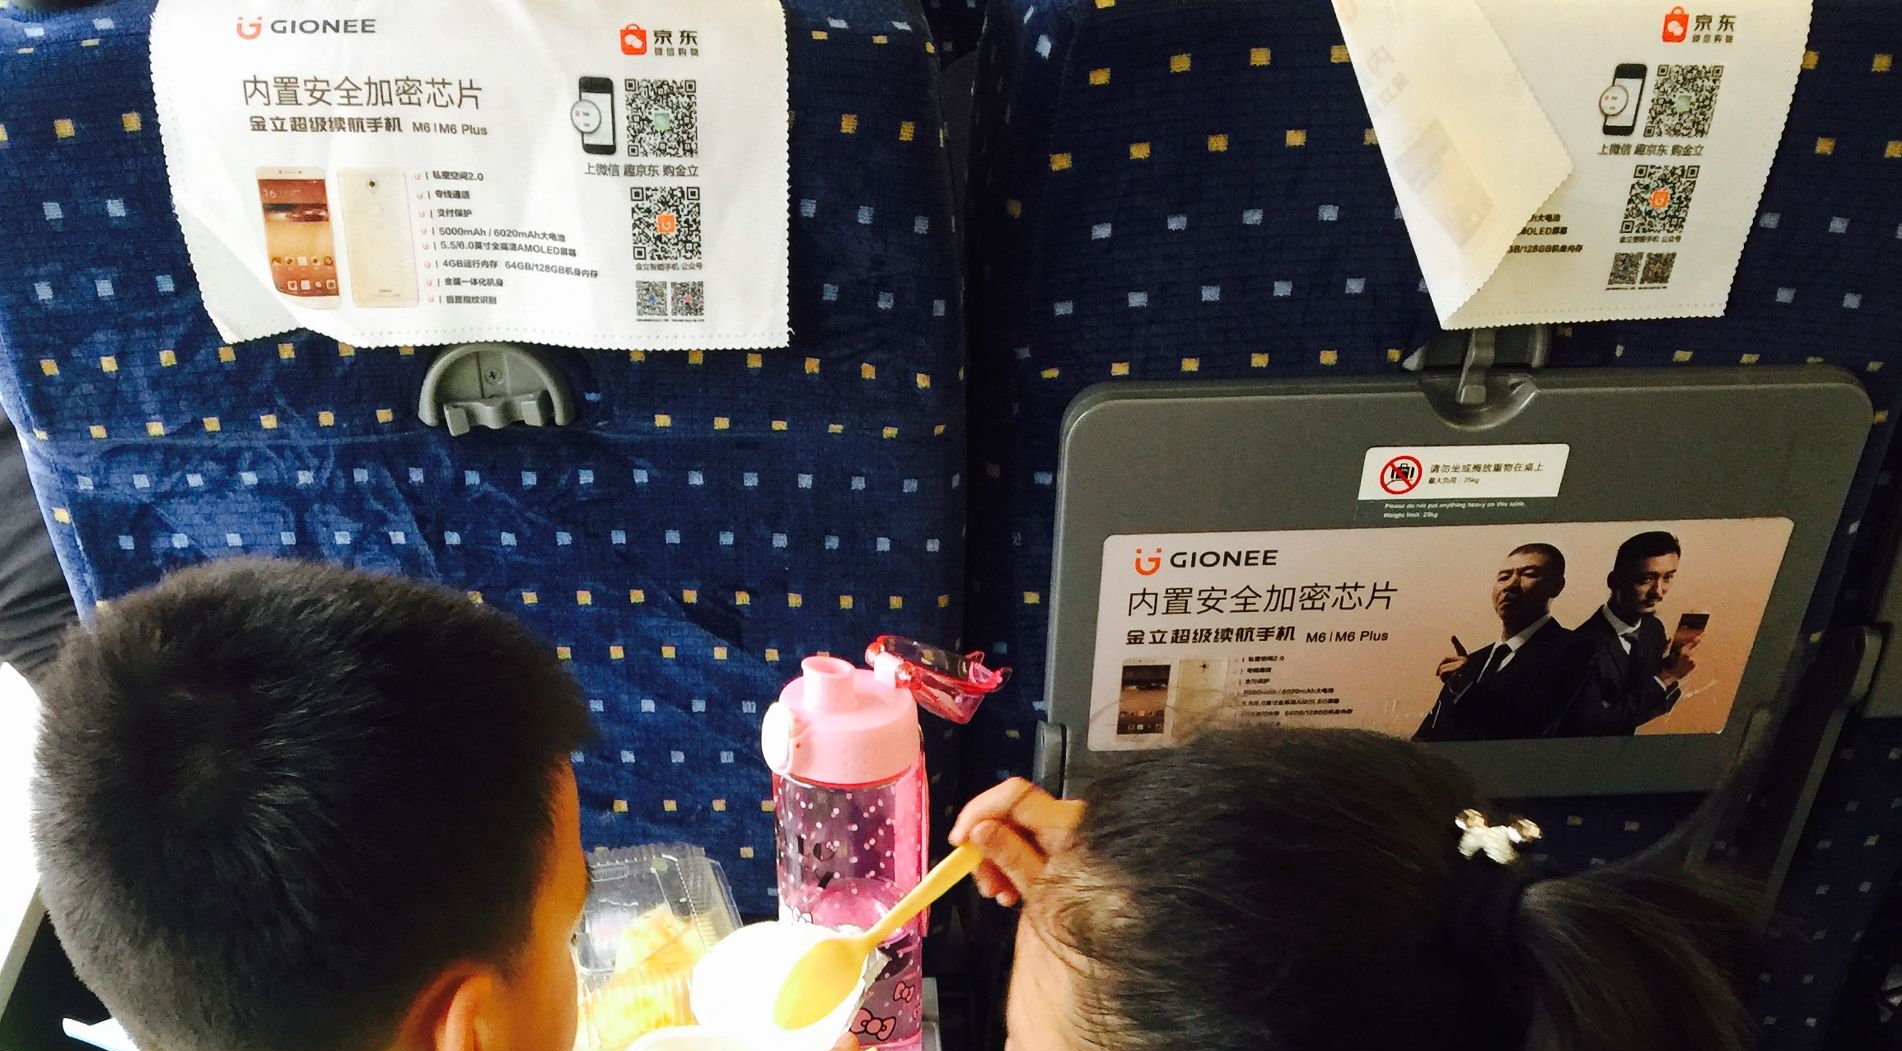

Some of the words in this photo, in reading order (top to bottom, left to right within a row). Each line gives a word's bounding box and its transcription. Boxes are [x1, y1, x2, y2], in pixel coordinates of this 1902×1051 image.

[270, 18, 376, 34] GIONEE
[1694, 14, 1737, 32] 京东
[654, 29, 698, 46] 京东
[242, 74, 482, 109] 内置安全加密芯片
[249, 115, 403, 133] 金立超级续航手机
[412, 121, 430, 133] M6
[439, 122, 457, 134] M6
[461, 123, 488, 136] Plus
[584, 162, 620, 177] 上微信
[663, 164, 699, 178] 购金立
[439, 227, 486, 236] 5000mAh
[1169, 549, 1279, 568] GIONEE
[1127, 580, 1399, 618] 内置安全加密芯片
[1125, 625, 1296, 646] 金立超级续航手机
[1305, 631, 1326, 643] M6
[1335, 631, 1356, 643] M6
[1359, 630, 1389, 642] Plus
